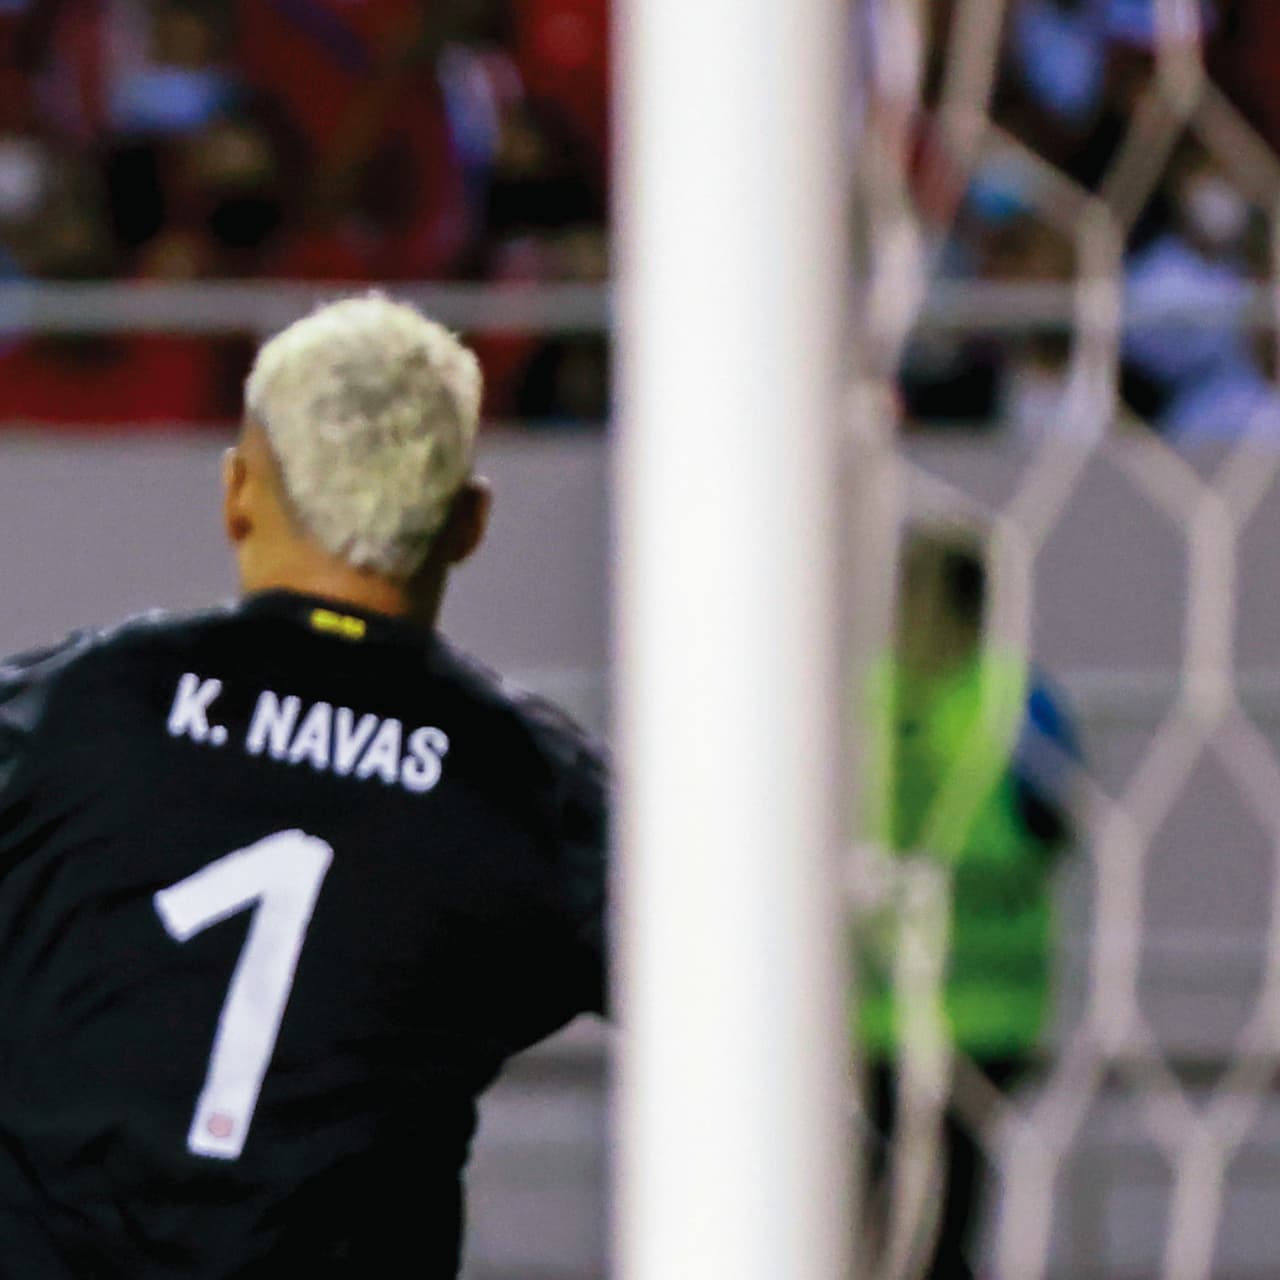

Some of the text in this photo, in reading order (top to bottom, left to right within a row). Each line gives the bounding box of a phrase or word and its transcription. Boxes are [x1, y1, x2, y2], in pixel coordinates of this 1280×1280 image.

[167, 671, 451, 795] K. NAVAS
[152, 827, 335, 1161] 1
